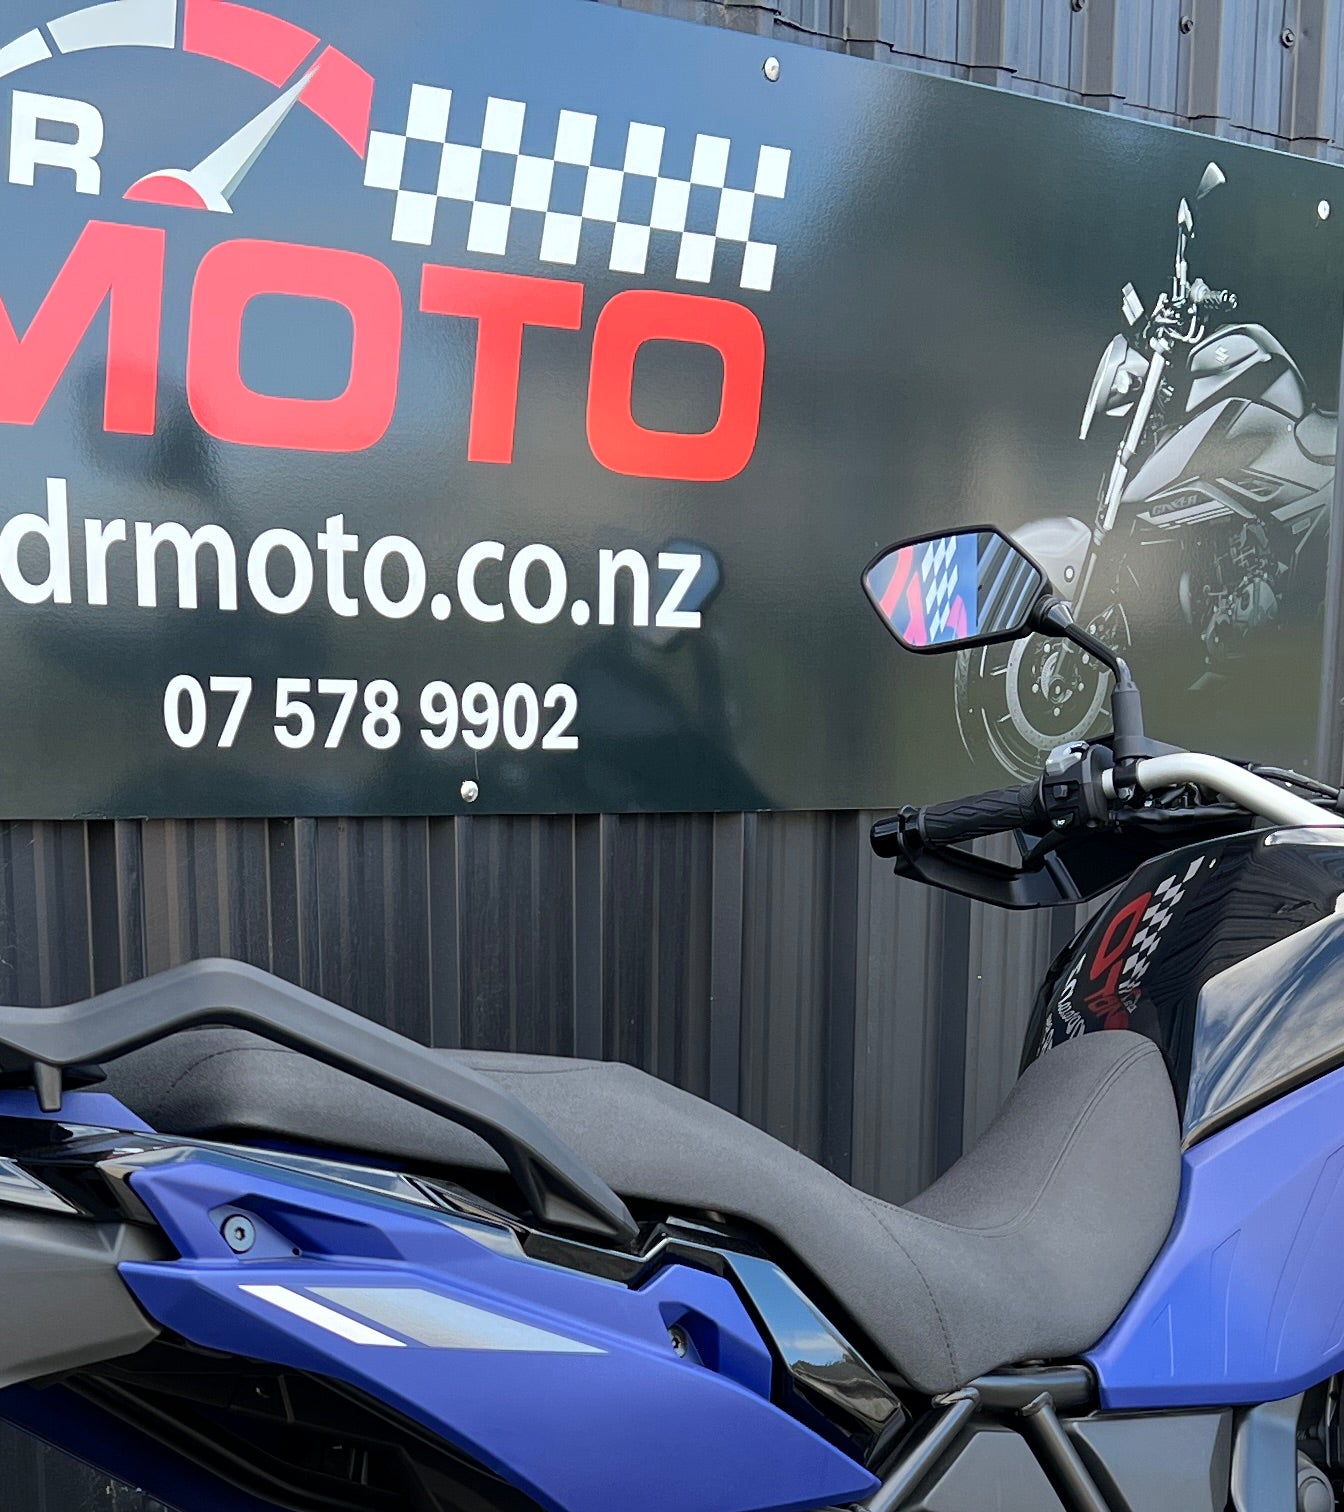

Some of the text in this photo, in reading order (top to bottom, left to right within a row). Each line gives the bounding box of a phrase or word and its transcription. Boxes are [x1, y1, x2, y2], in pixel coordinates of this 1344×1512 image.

[163, 674, 579, 751] 07 578 9902
